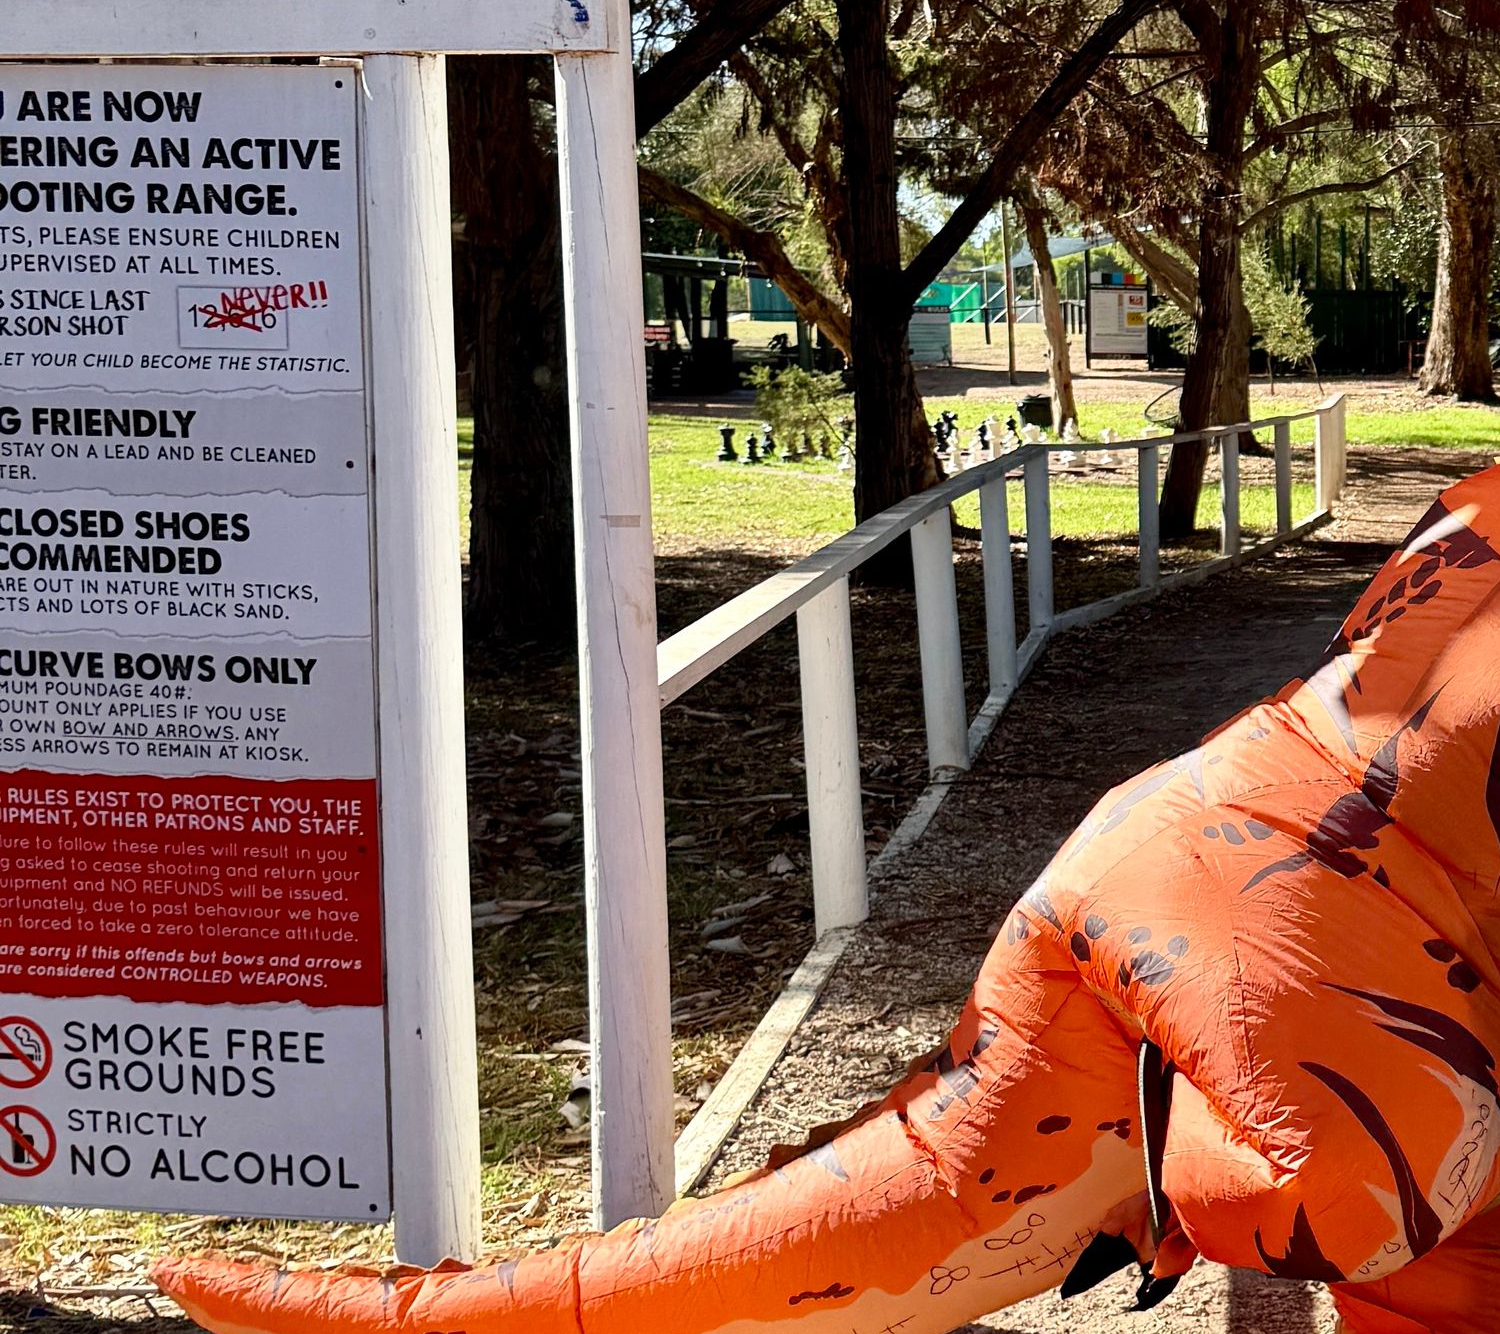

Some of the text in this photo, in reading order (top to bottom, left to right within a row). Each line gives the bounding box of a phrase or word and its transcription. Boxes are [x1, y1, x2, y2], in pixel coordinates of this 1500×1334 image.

[15, 90, 92, 122] ARE
[102, 90, 203, 124] NOW
[129, 136, 191, 169] AN
[201, 137, 341, 171] ACTIVE
[0, 180, 298, 217] OTING RANGE.
[39, 226, 121, 246] PLEASE
[128, 227, 220, 248] ENSURE
[226, 228, 340, 250] CHILDREN
[125, 255, 152, 274] AT
[159, 255, 200, 275] ALL
[205, 256, 282, 277] TIMES.
[9, 288, 86, 311] SINCE
[89, 289, 152, 312] LAST
[66, 314, 130, 337] SHOT
[30, 352, 350, 374] YOUR CHILD BECOME THE STATISTIC.
[31, 407, 197, 439] FRIENDLY
[0, 441, 317, 464] STAY ON A LEAD AND BE CLEANED
[134, 510, 251, 543] SHOES
[33, 577, 319, 604] OUT IN NATURE WITH STICKS,
[36, 597, 290, 620] AND LOTS OF BLACK SAND.
[113, 652, 217, 683] BOWS
[224, 655, 318, 686] ONLY
[44, 680, 144, 699] POUNDAGE
[9, 719, 281, 743] OWN BOW AND ARROWS. ANY
[31, 738, 309, 763] ARROWS TO REMAIN AT KIOSK.
[7, 787, 69, 806] RULES
[75, 790, 130, 808] EXIST
[136, 792, 164, 809] TO
[171, 793, 263, 812] PROTECT
[322, 799, 362, 816] THE
[73, 878, 106, 893] and
[110, 878, 137, 894] NO
[142, 878, 224, 897] REFUNDS
[229, 884, 256, 898] will
[261, 884, 284, 900] be
[63, 1020, 326, 1065] SMOKE FREE
[64, 1057, 276, 1099] GROUNDS
[67, 1108, 208, 1139] STRICTLY
[69, 1143, 361, 1190] NO ALCOHOL
